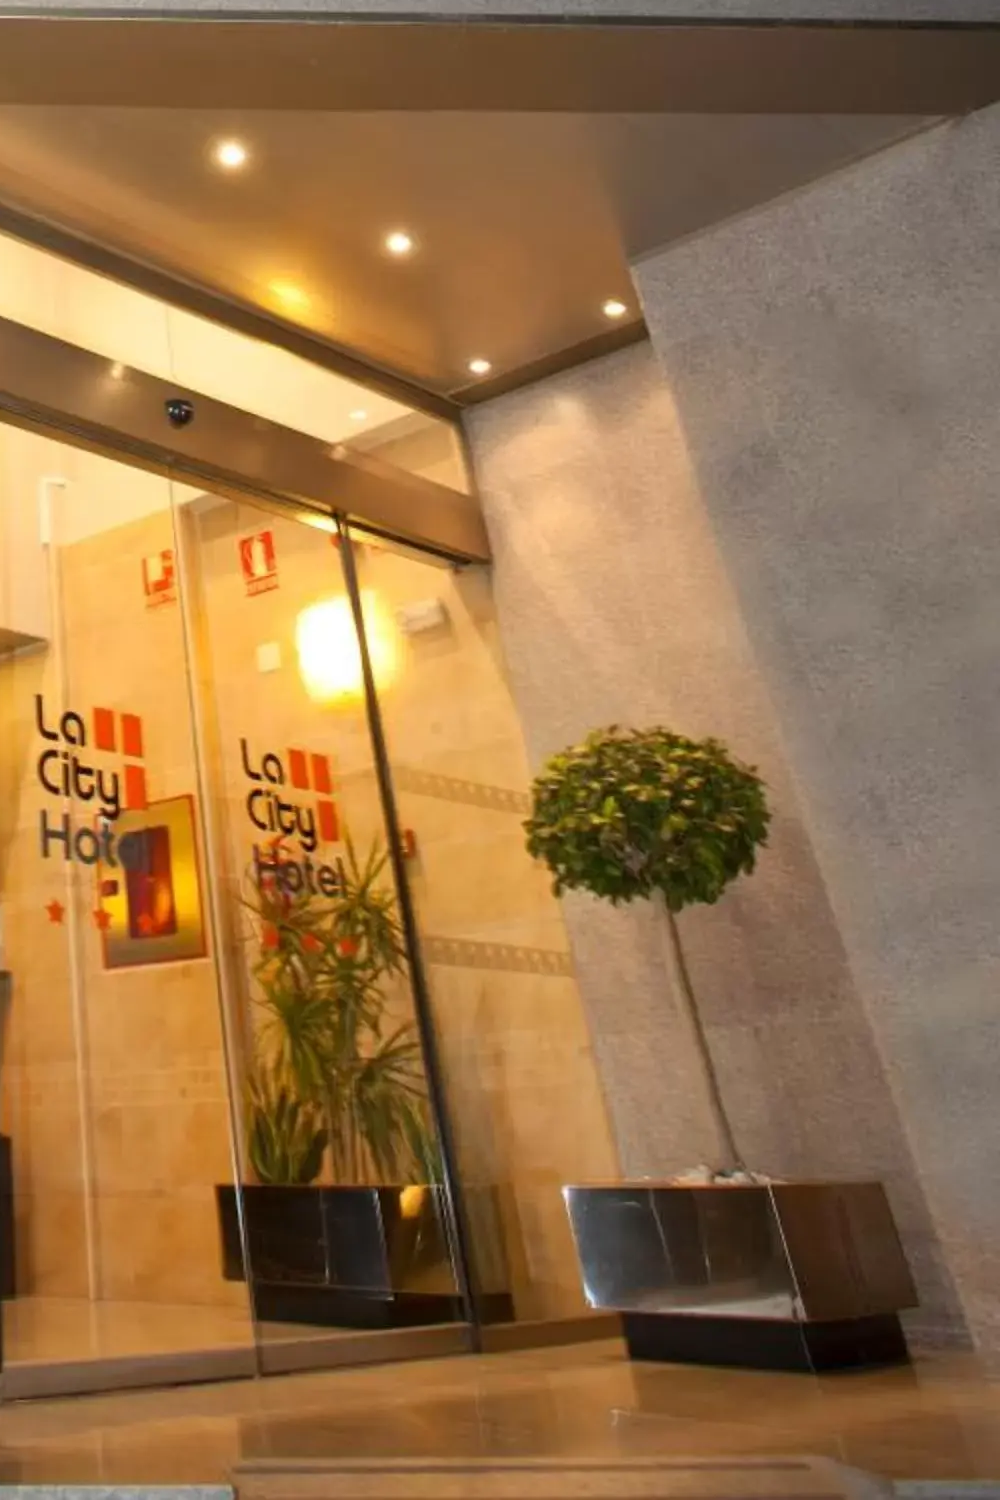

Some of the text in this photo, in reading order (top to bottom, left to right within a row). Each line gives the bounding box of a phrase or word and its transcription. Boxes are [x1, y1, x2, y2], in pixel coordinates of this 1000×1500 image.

[34, 693, 87, 747] La
[37, 749, 121, 820] City
[240, 738, 285, 785] La
[247, 787, 317, 853] City
[252, 842, 348, 897] Hotel
